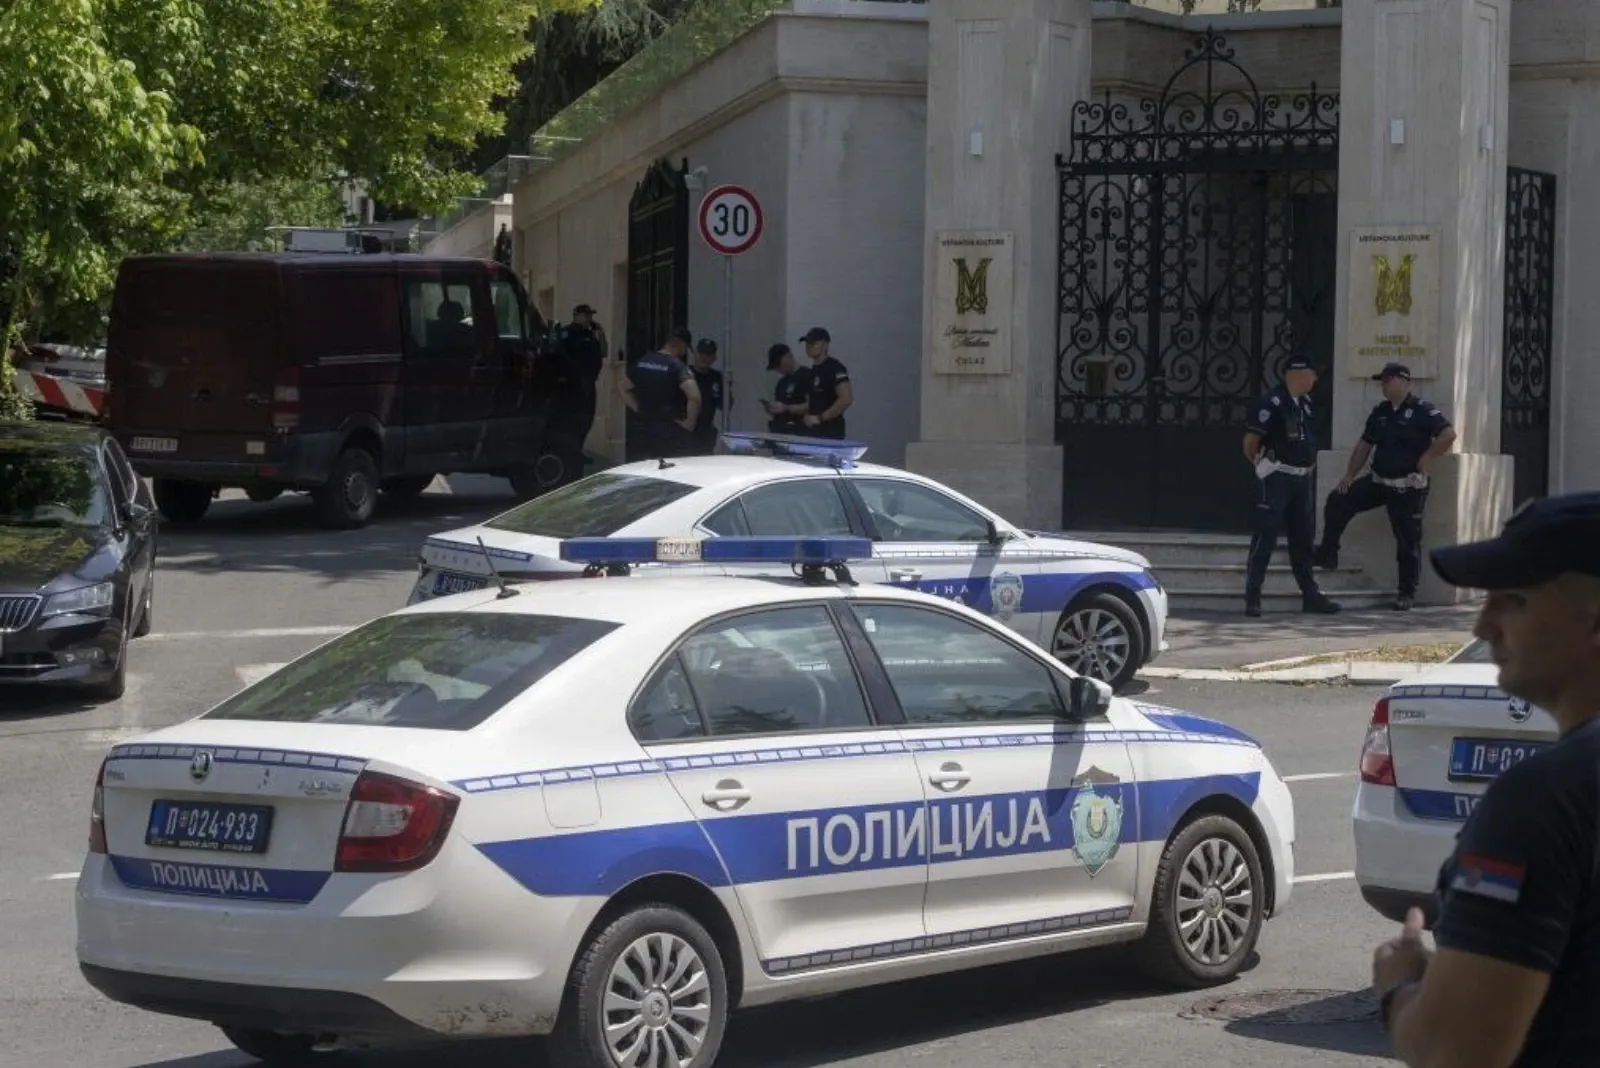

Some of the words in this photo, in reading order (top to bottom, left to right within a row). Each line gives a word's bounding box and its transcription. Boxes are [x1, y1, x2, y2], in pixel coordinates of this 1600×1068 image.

[714, 203, 749, 236] 30
[786, 797, 1052, 871] ПОЛИЦИЈА
[150, 862, 269, 893] ПОЛИЦИЈА
